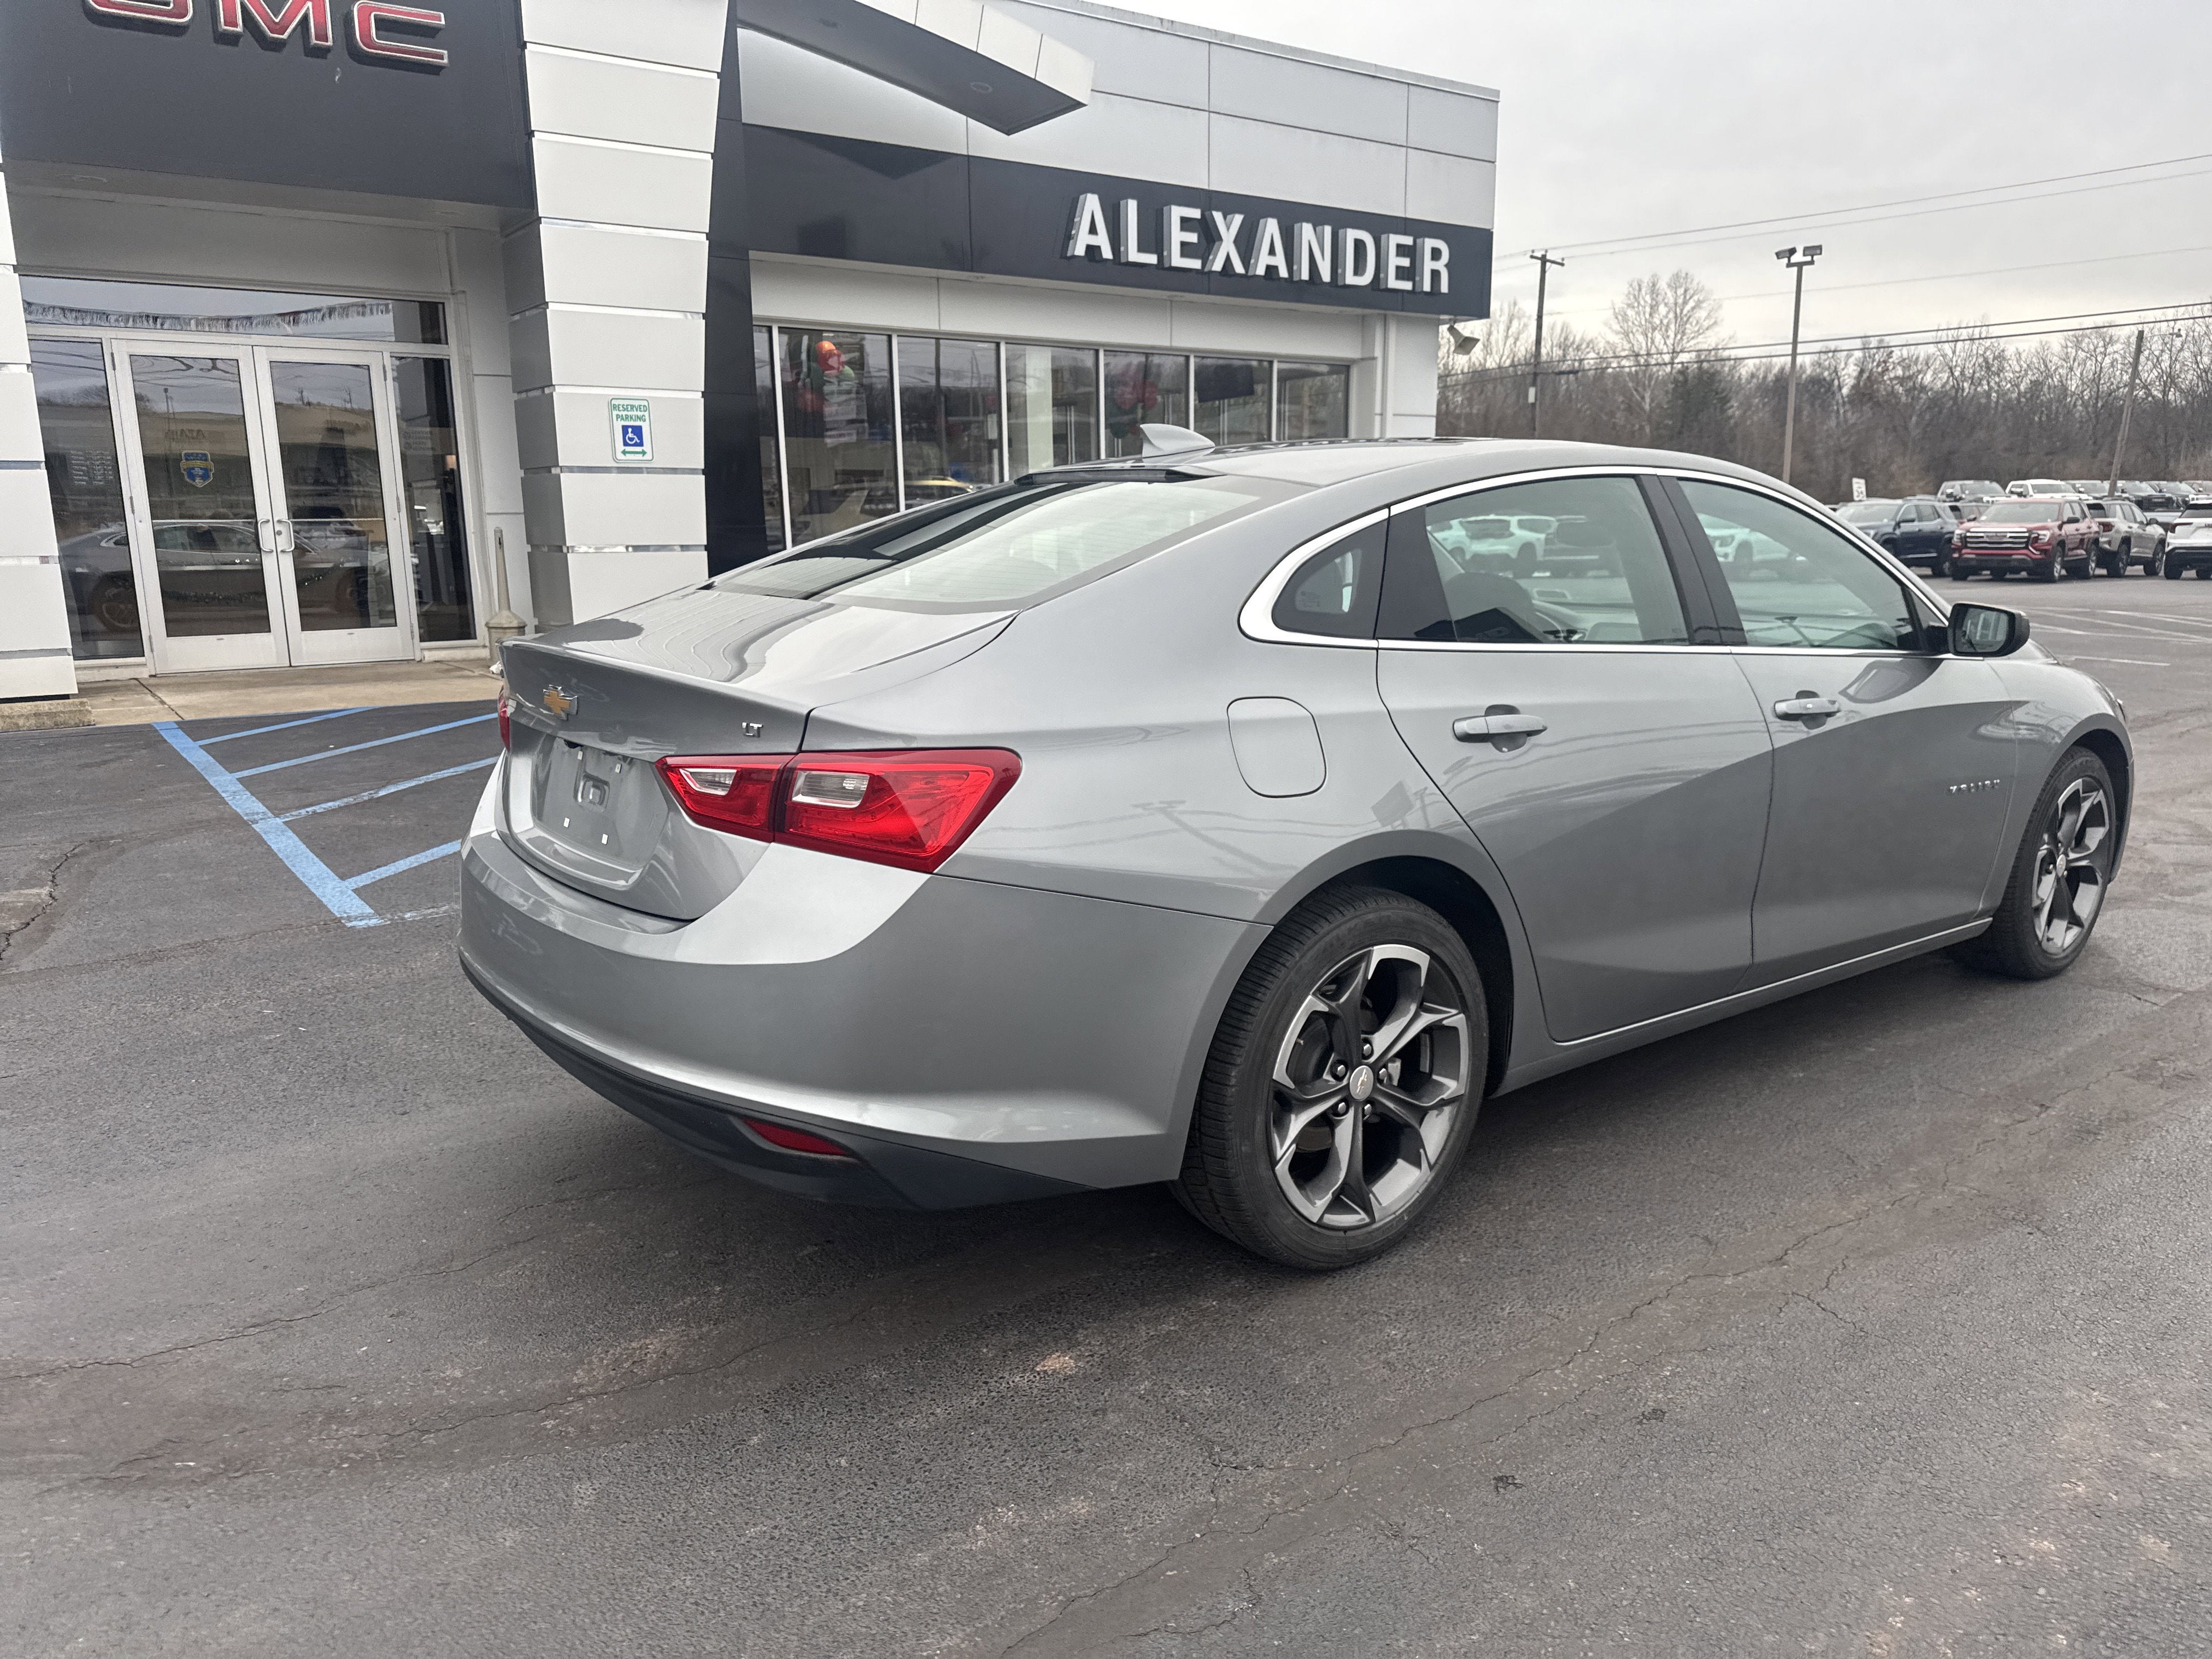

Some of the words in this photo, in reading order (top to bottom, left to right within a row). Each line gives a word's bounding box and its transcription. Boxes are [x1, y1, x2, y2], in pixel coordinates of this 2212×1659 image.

[1068, 193, 1449, 294] ALEXANDER
[613, 404, 647, 412] RESERVED
[742, 722, 764, 738] LT
